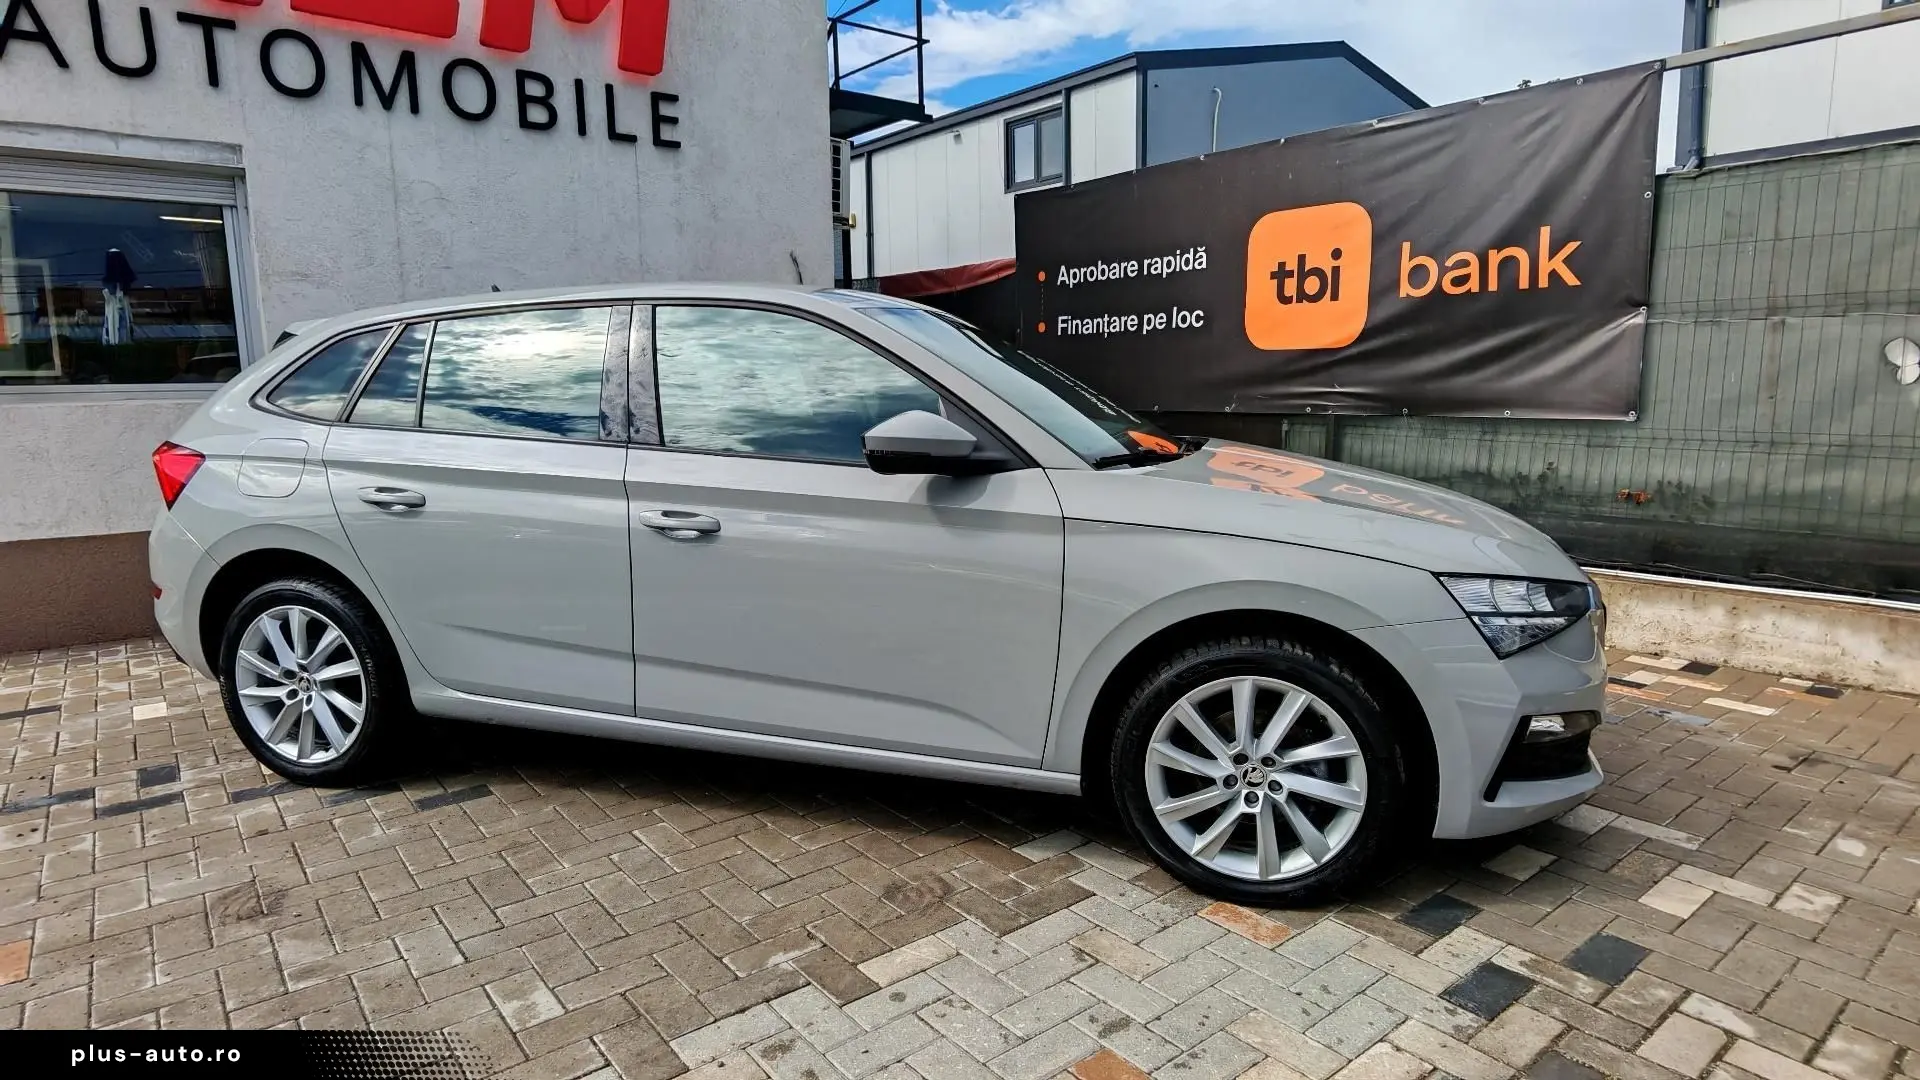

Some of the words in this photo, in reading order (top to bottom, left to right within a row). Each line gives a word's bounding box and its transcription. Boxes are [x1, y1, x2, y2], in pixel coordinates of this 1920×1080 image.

[0, 0, 682, 149] AUTOMOBILE
[1057, 260, 1139, 288] Aprobare
[1144, 246, 1207, 278] rapidă
[1270, 248, 1342, 304] tbi
[1400, 226, 1583, 298] bank
[1143, 312, 1167, 334] pe
[1172, 306, 1204, 328] loc
